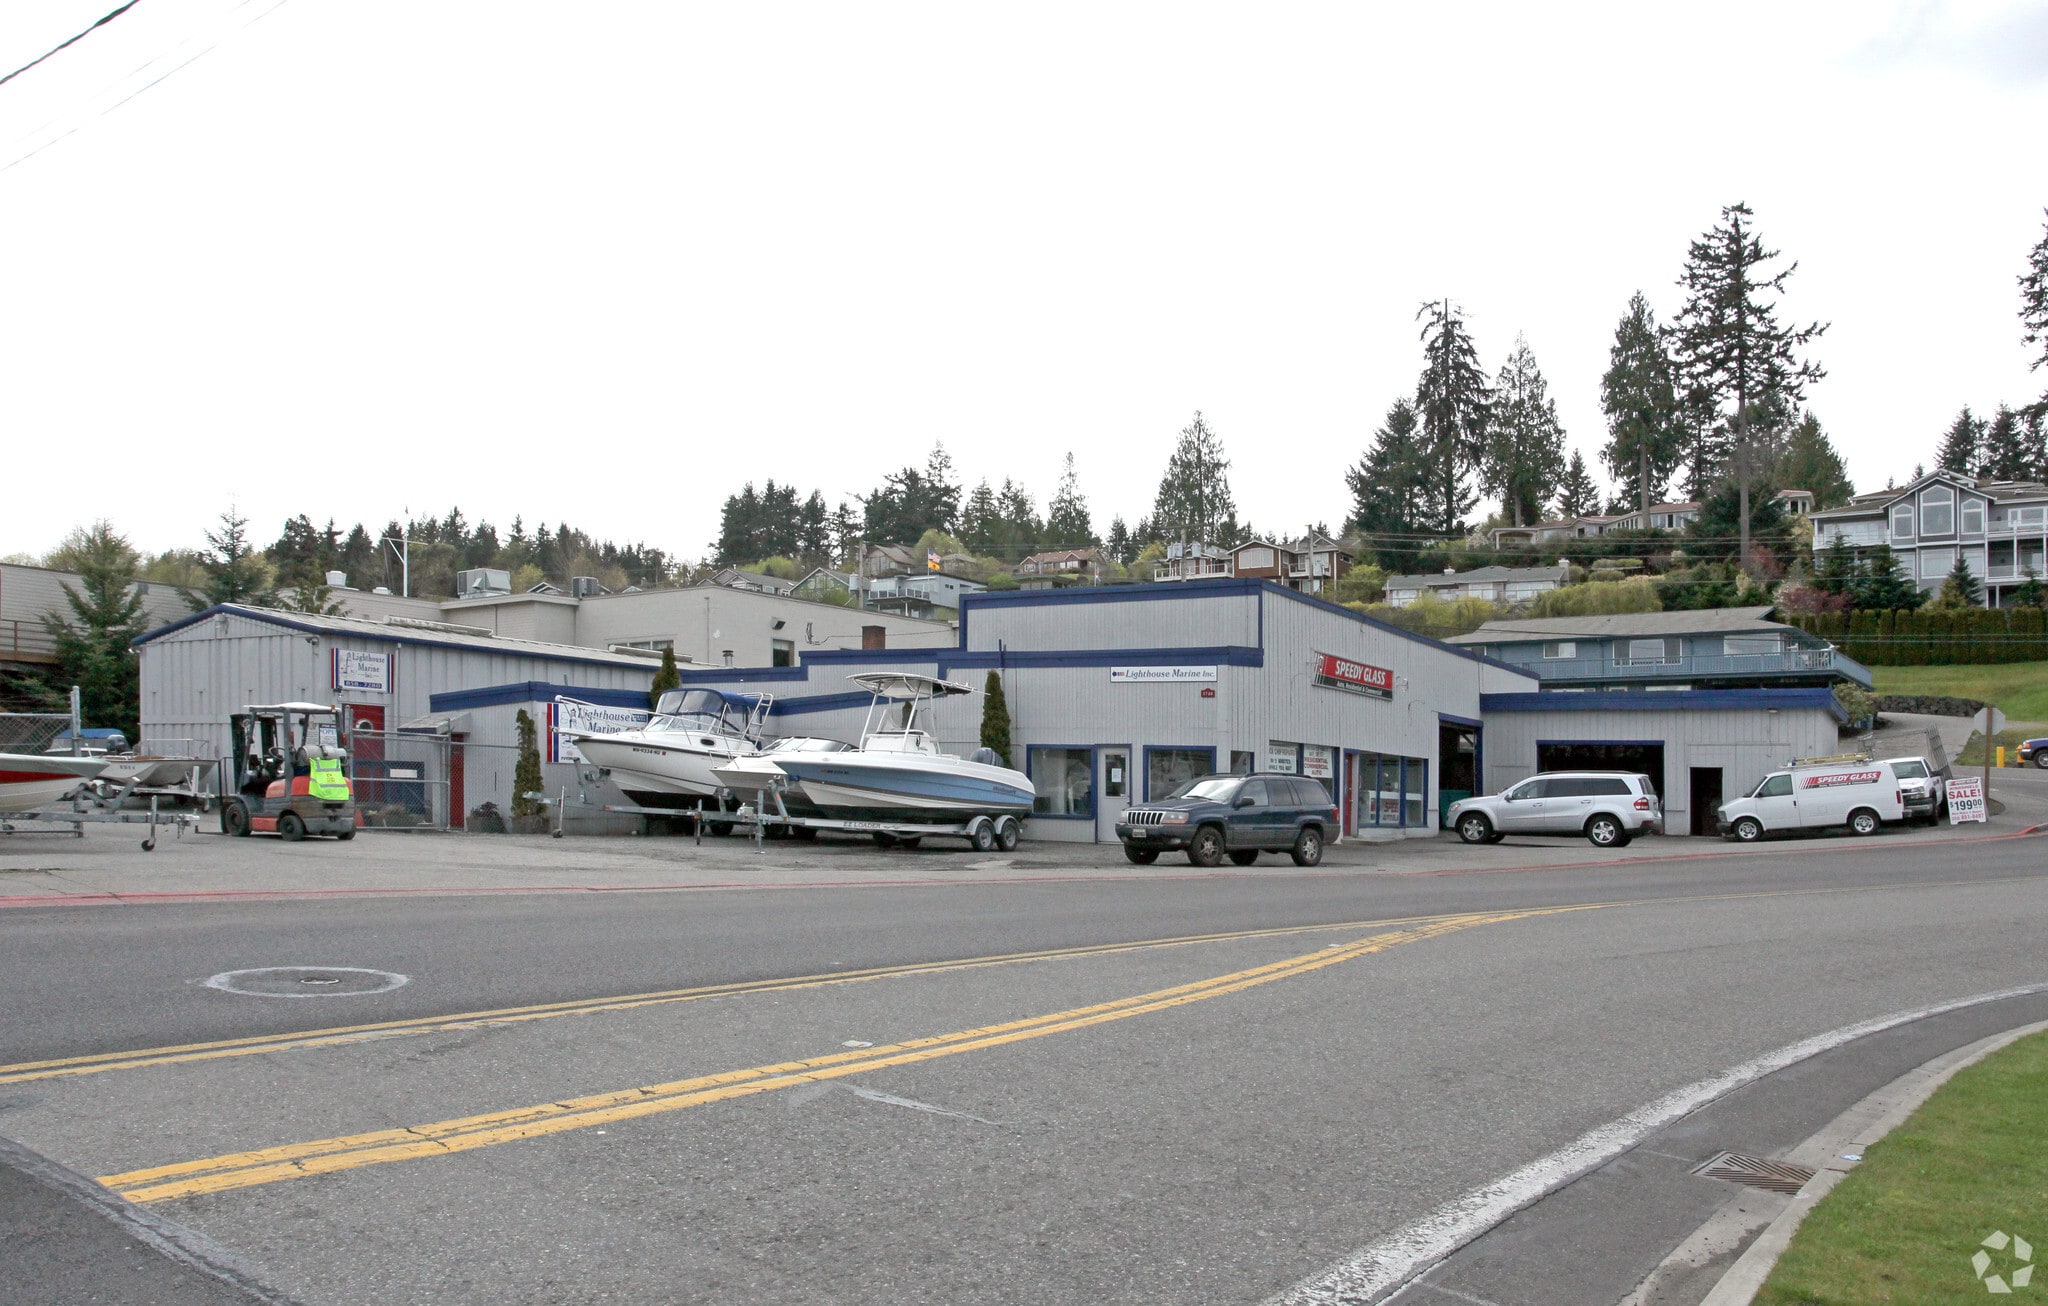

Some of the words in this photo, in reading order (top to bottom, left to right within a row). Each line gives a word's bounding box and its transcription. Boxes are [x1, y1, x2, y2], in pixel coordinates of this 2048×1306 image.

[352, 652, 385, 663] Lighthouse
[358, 662, 380, 672] Marine
[1335, 660, 1364, 680] SPEEDY
[1364, 668, 1386, 685] GLASS
[1126, 669, 1170, 680] Lighthouse
[1172, 668, 1200, 678] Marine
[1817, 774, 1849, 784] SPEEDY
[1850, 772, 1877, 780] GLASS
[1948, 789, 1981, 799] SALE!
